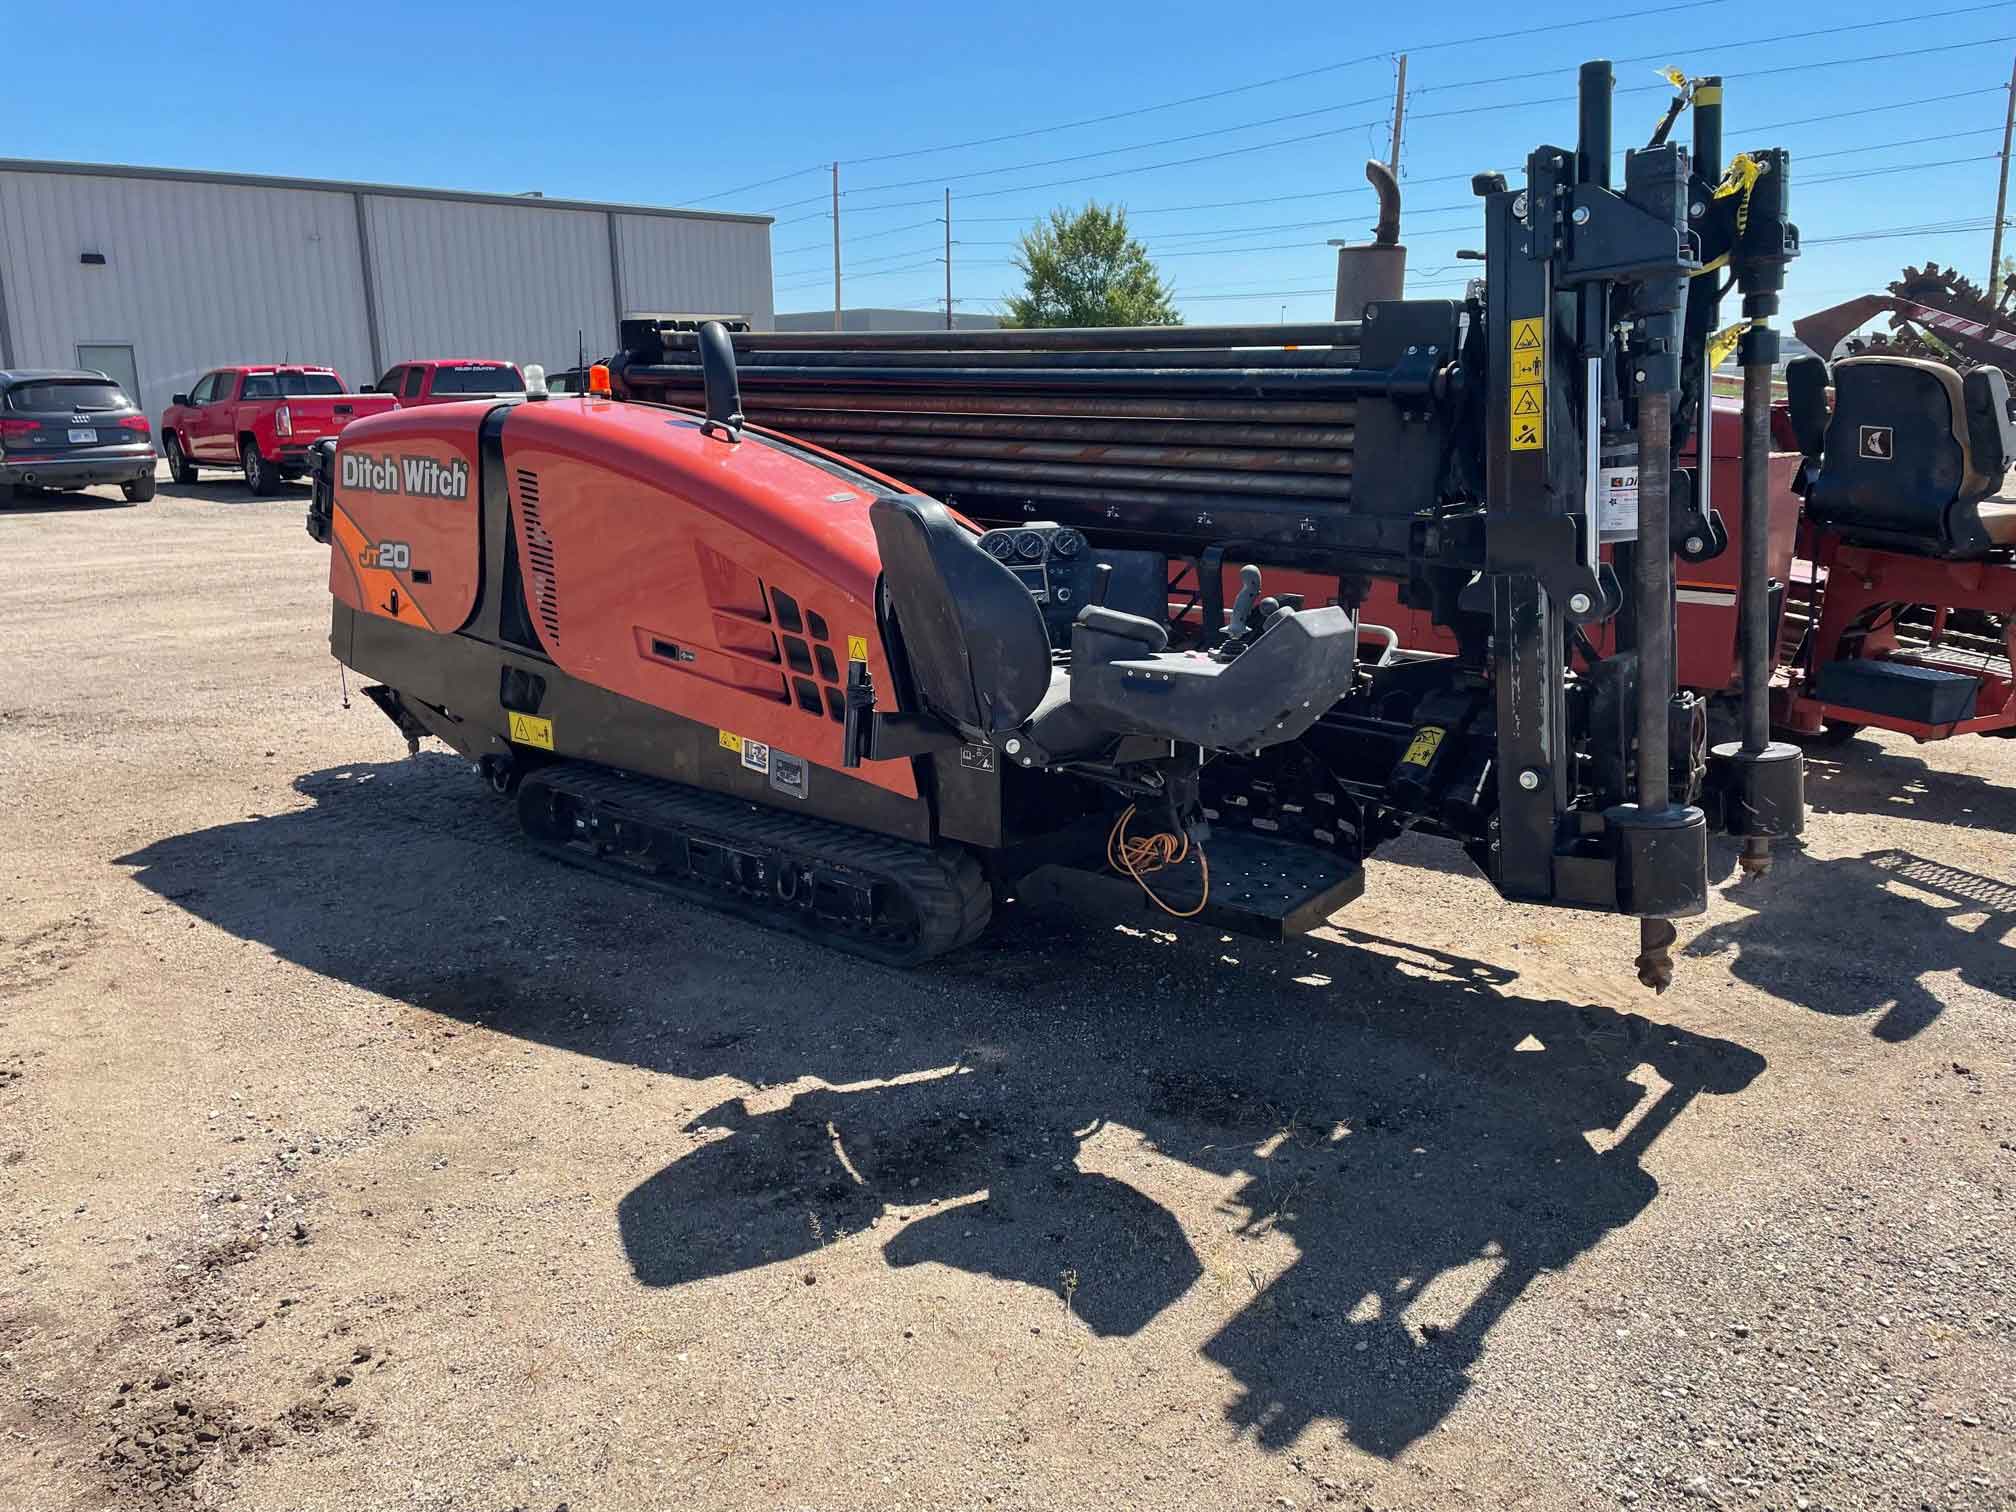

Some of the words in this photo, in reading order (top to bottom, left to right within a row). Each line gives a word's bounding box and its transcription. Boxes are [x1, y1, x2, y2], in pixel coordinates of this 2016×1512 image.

[342, 454, 399, 491] Ditch
[402, 459, 467, 497] Witch
[360, 543, 410, 569] JT20
